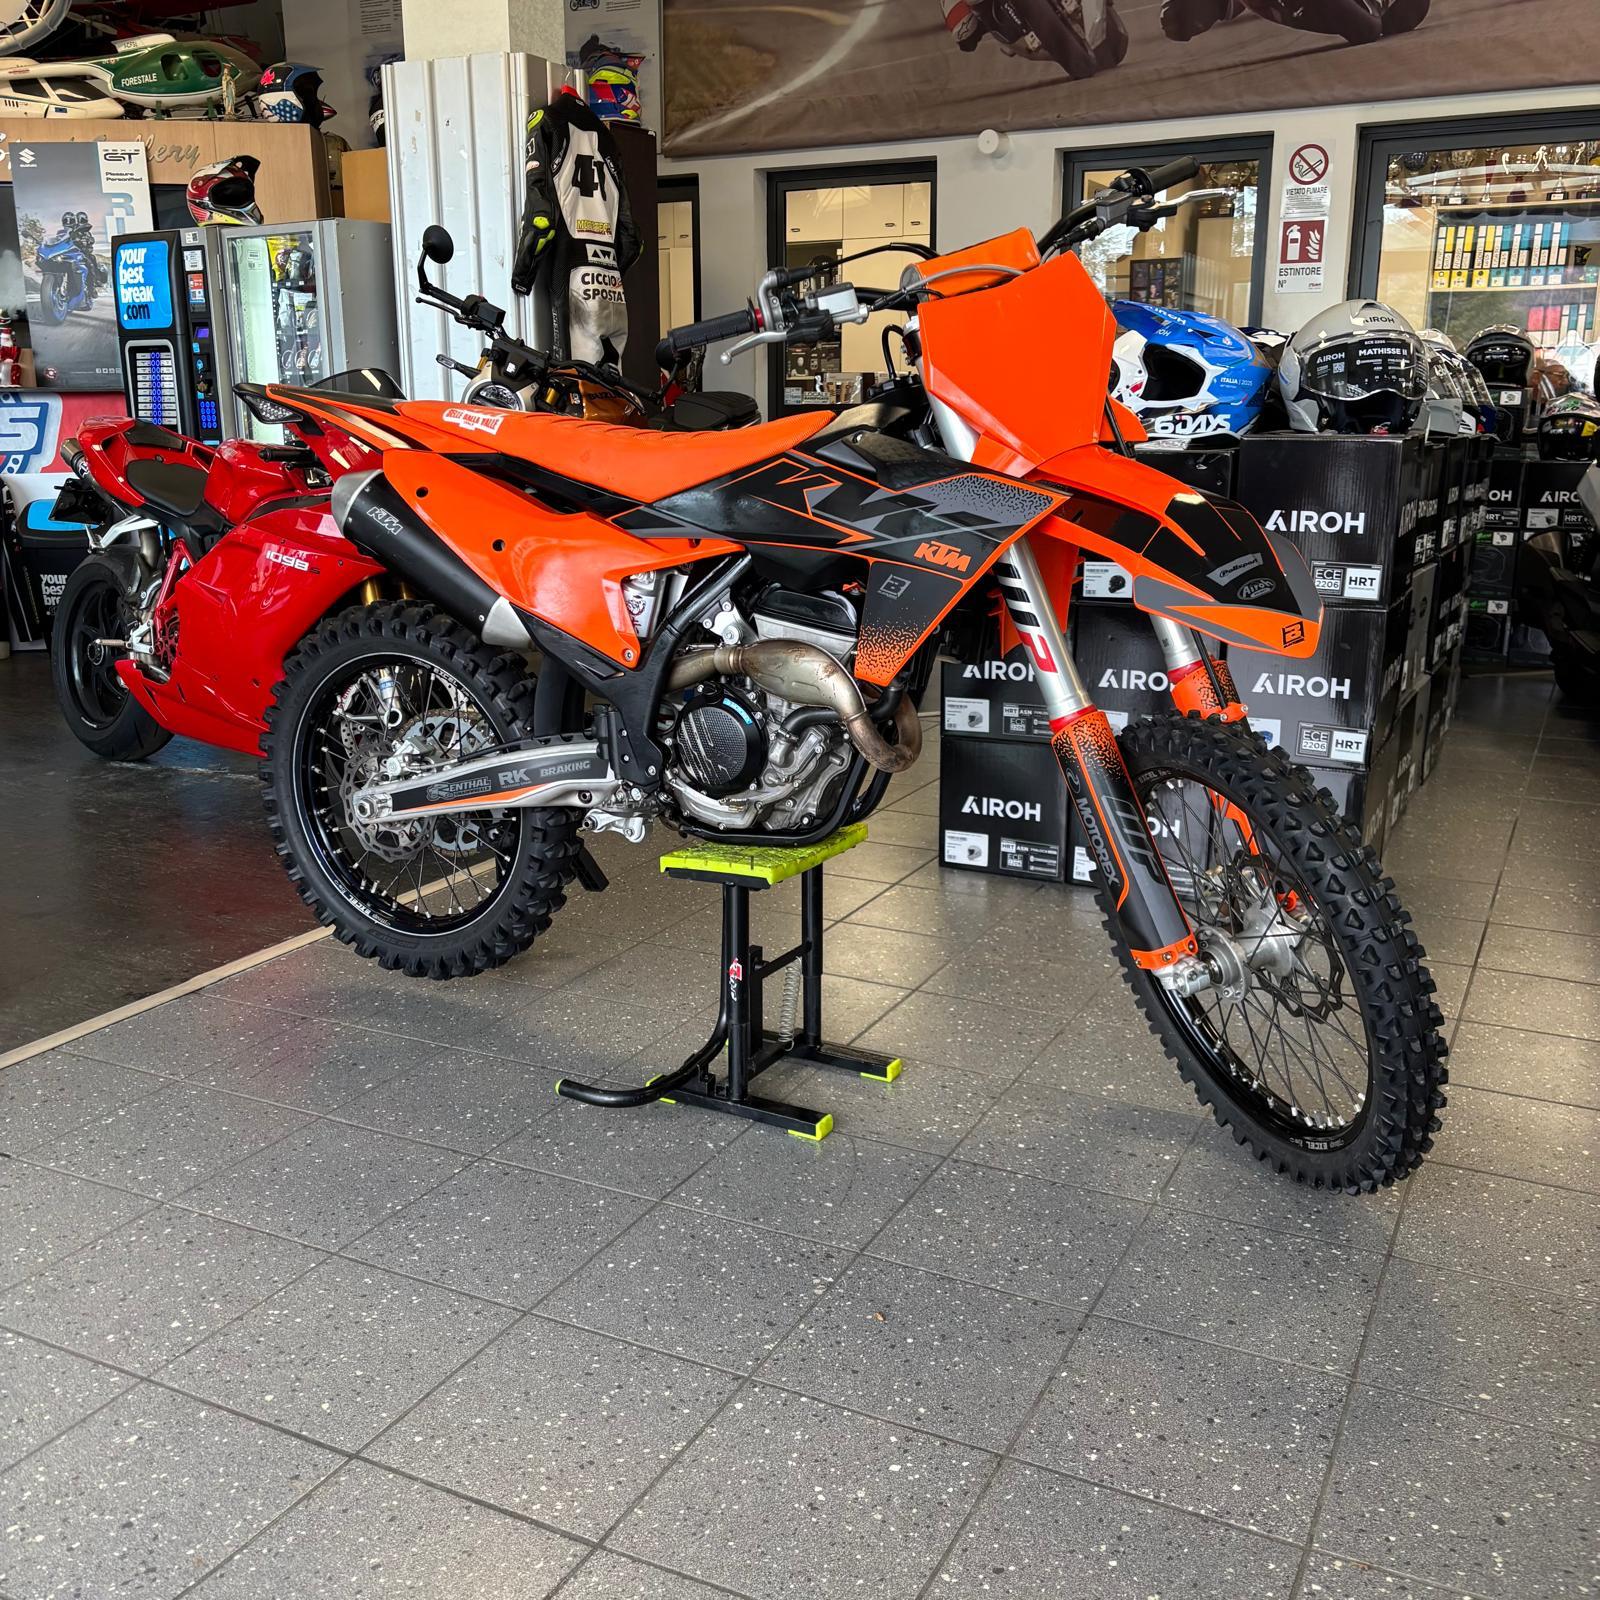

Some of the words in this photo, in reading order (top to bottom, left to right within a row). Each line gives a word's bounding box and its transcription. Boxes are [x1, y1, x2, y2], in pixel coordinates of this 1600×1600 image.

[121, 73, 158, 88] FORESTALE
[103, 152, 140, 165] GT
[1286, 187, 1305, 196] VIETATO
[1306, 186, 1328, 195] FUMARE
[120, 248, 147, 265] your
[119, 264, 144, 284] best
[1278, 266, 1321, 276] ESTINTORE
[581, 272, 617, 288] CICCIO
[120, 284, 155, 304] break
[124, 303, 150, 321] .com
[1316, 352, 1346, 364] AIROH
[1358, 347, 1401, 357] MATHISSE
[1220, 377, 1238, 385] ITALIA
[1154, 414, 1231, 434] 6DAYS
[1540, 490, 1581, 502] AIRO
[366, 506, 403, 536] KTM
[1264, 509, 1366, 535] AIROH
[266, 550, 309, 571] 1098
[913, 540, 972, 572] KTM
[40, 574, 68, 586] your
[1315, 569, 1342, 580] ECE
[1348, 576, 1377, 587] HRT
[1242, 579, 1274, 598] Airoh
[1316, 579, 1339, 589] 2206
[1098, 668, 1175, 692] AIRO
[1251, 672, 1351, 700] AIROH
[1303, 730, 1329, 741] ECE
[1303, 741, 1326, 750] 2206
[1335, 739, 1362, 750] HRT
[498, 767, 531, 786] RK
[540, 760, 591, 778] BRAKING
[961, 795, 1041, 822] AIROH
[1076, 797, 1120, 886] MOTOREX
[348, 894, 372, 915] EXCEL
